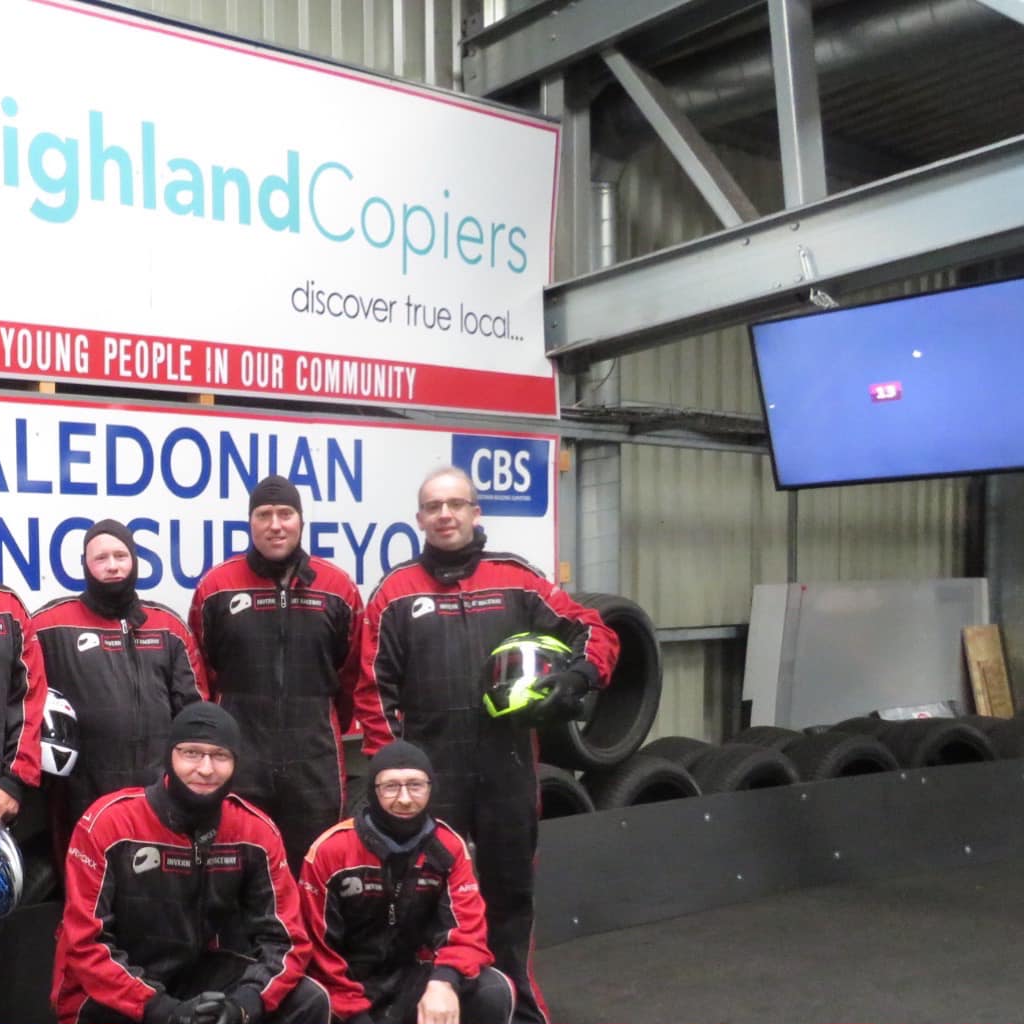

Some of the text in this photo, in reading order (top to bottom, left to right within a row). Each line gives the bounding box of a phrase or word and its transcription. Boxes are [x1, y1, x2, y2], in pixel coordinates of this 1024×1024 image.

[291, 280, 524, 343] discover true local...
[0, 326, 90, 374] YOUNG
[104, 337, 192, 382] PEOPLE
[206, 347, 228, 385] IN
[241, 351, 284, 389] OUR
[295, 355, 417, 400] COMMUNITY
[471, 448, 531, 492] CBS
